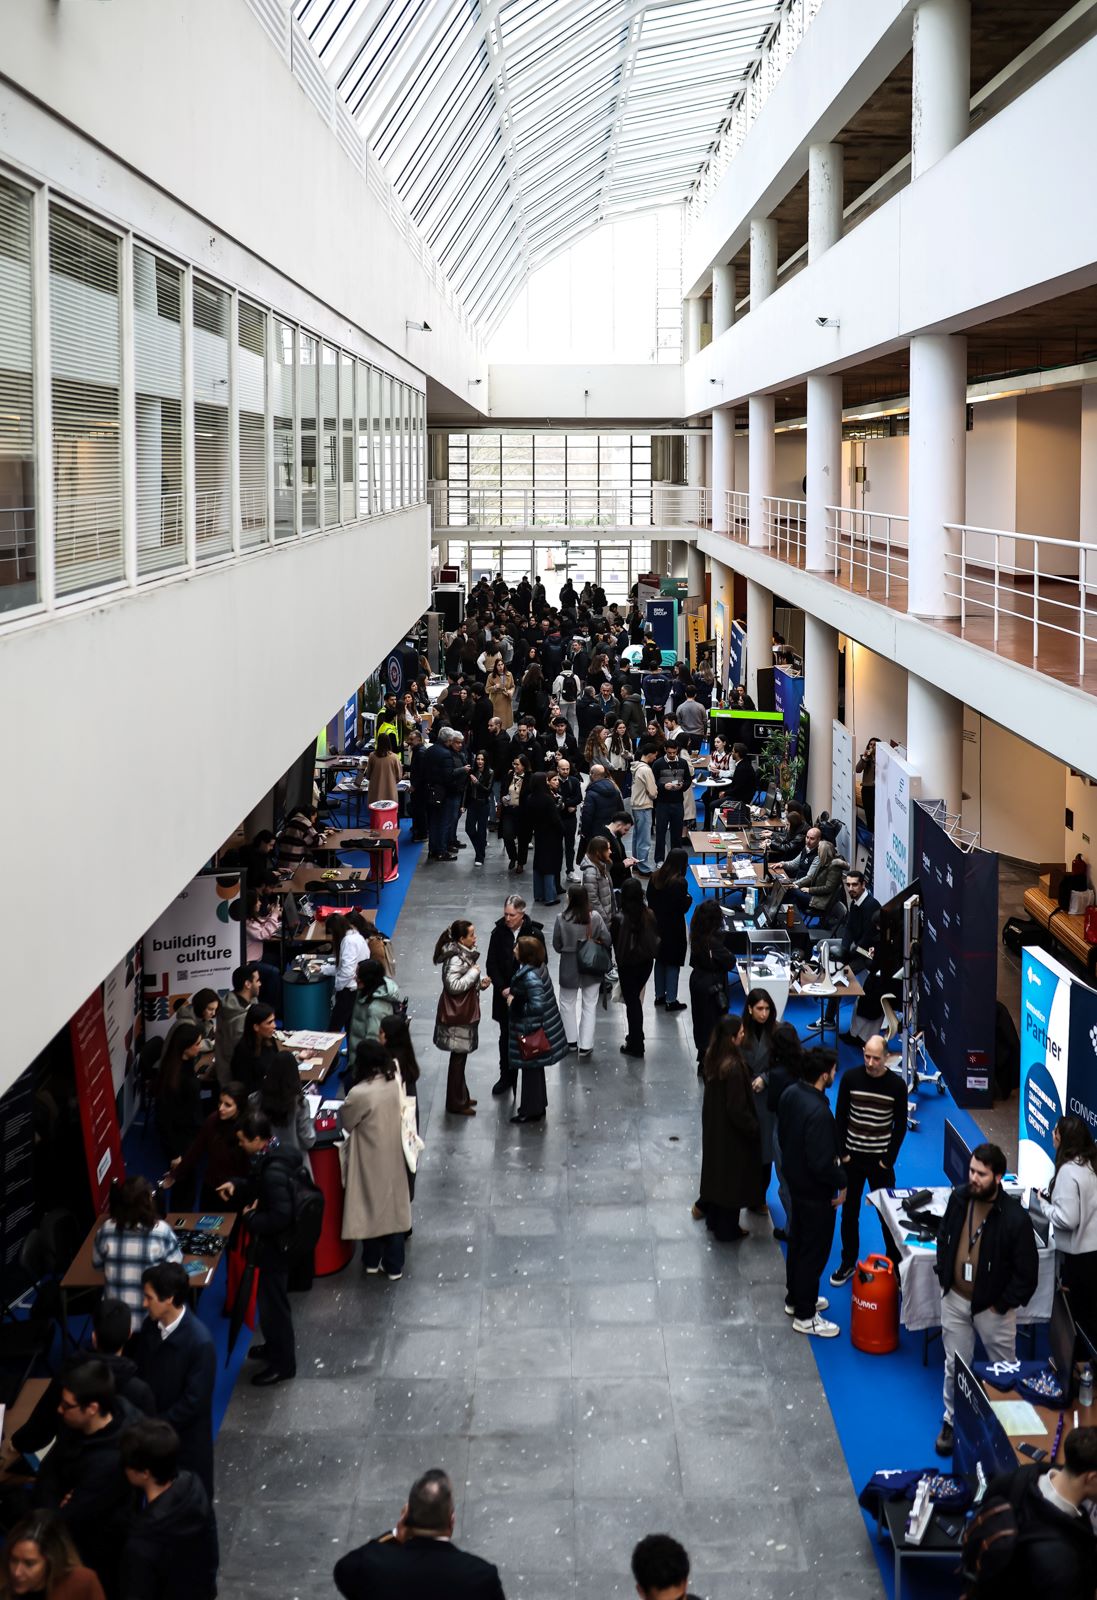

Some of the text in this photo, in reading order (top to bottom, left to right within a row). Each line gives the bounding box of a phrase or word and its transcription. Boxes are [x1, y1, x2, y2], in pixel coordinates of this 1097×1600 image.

[153, 934, 216, 952] building
[176, 948, 232, 964] culture
[1026, 1013, 1062, 1061] Partner
